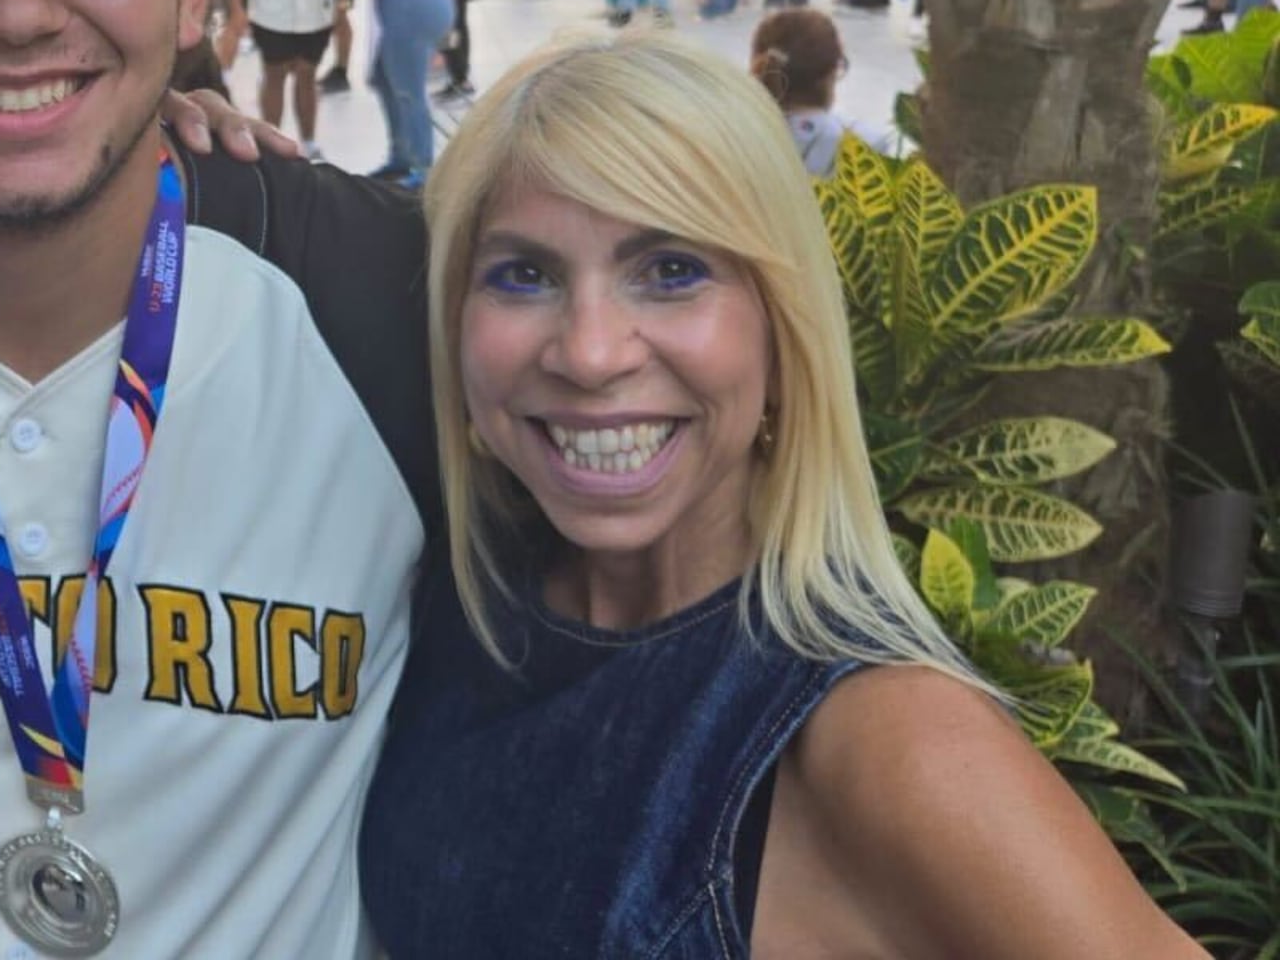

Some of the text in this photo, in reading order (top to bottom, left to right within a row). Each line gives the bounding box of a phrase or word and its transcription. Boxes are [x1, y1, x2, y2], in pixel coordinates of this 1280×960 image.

[154, 221, 169, 282] BASEBALL
[162, 231, 178, 304] WORLD CUP
[137, 584, 364, 721] RICO
